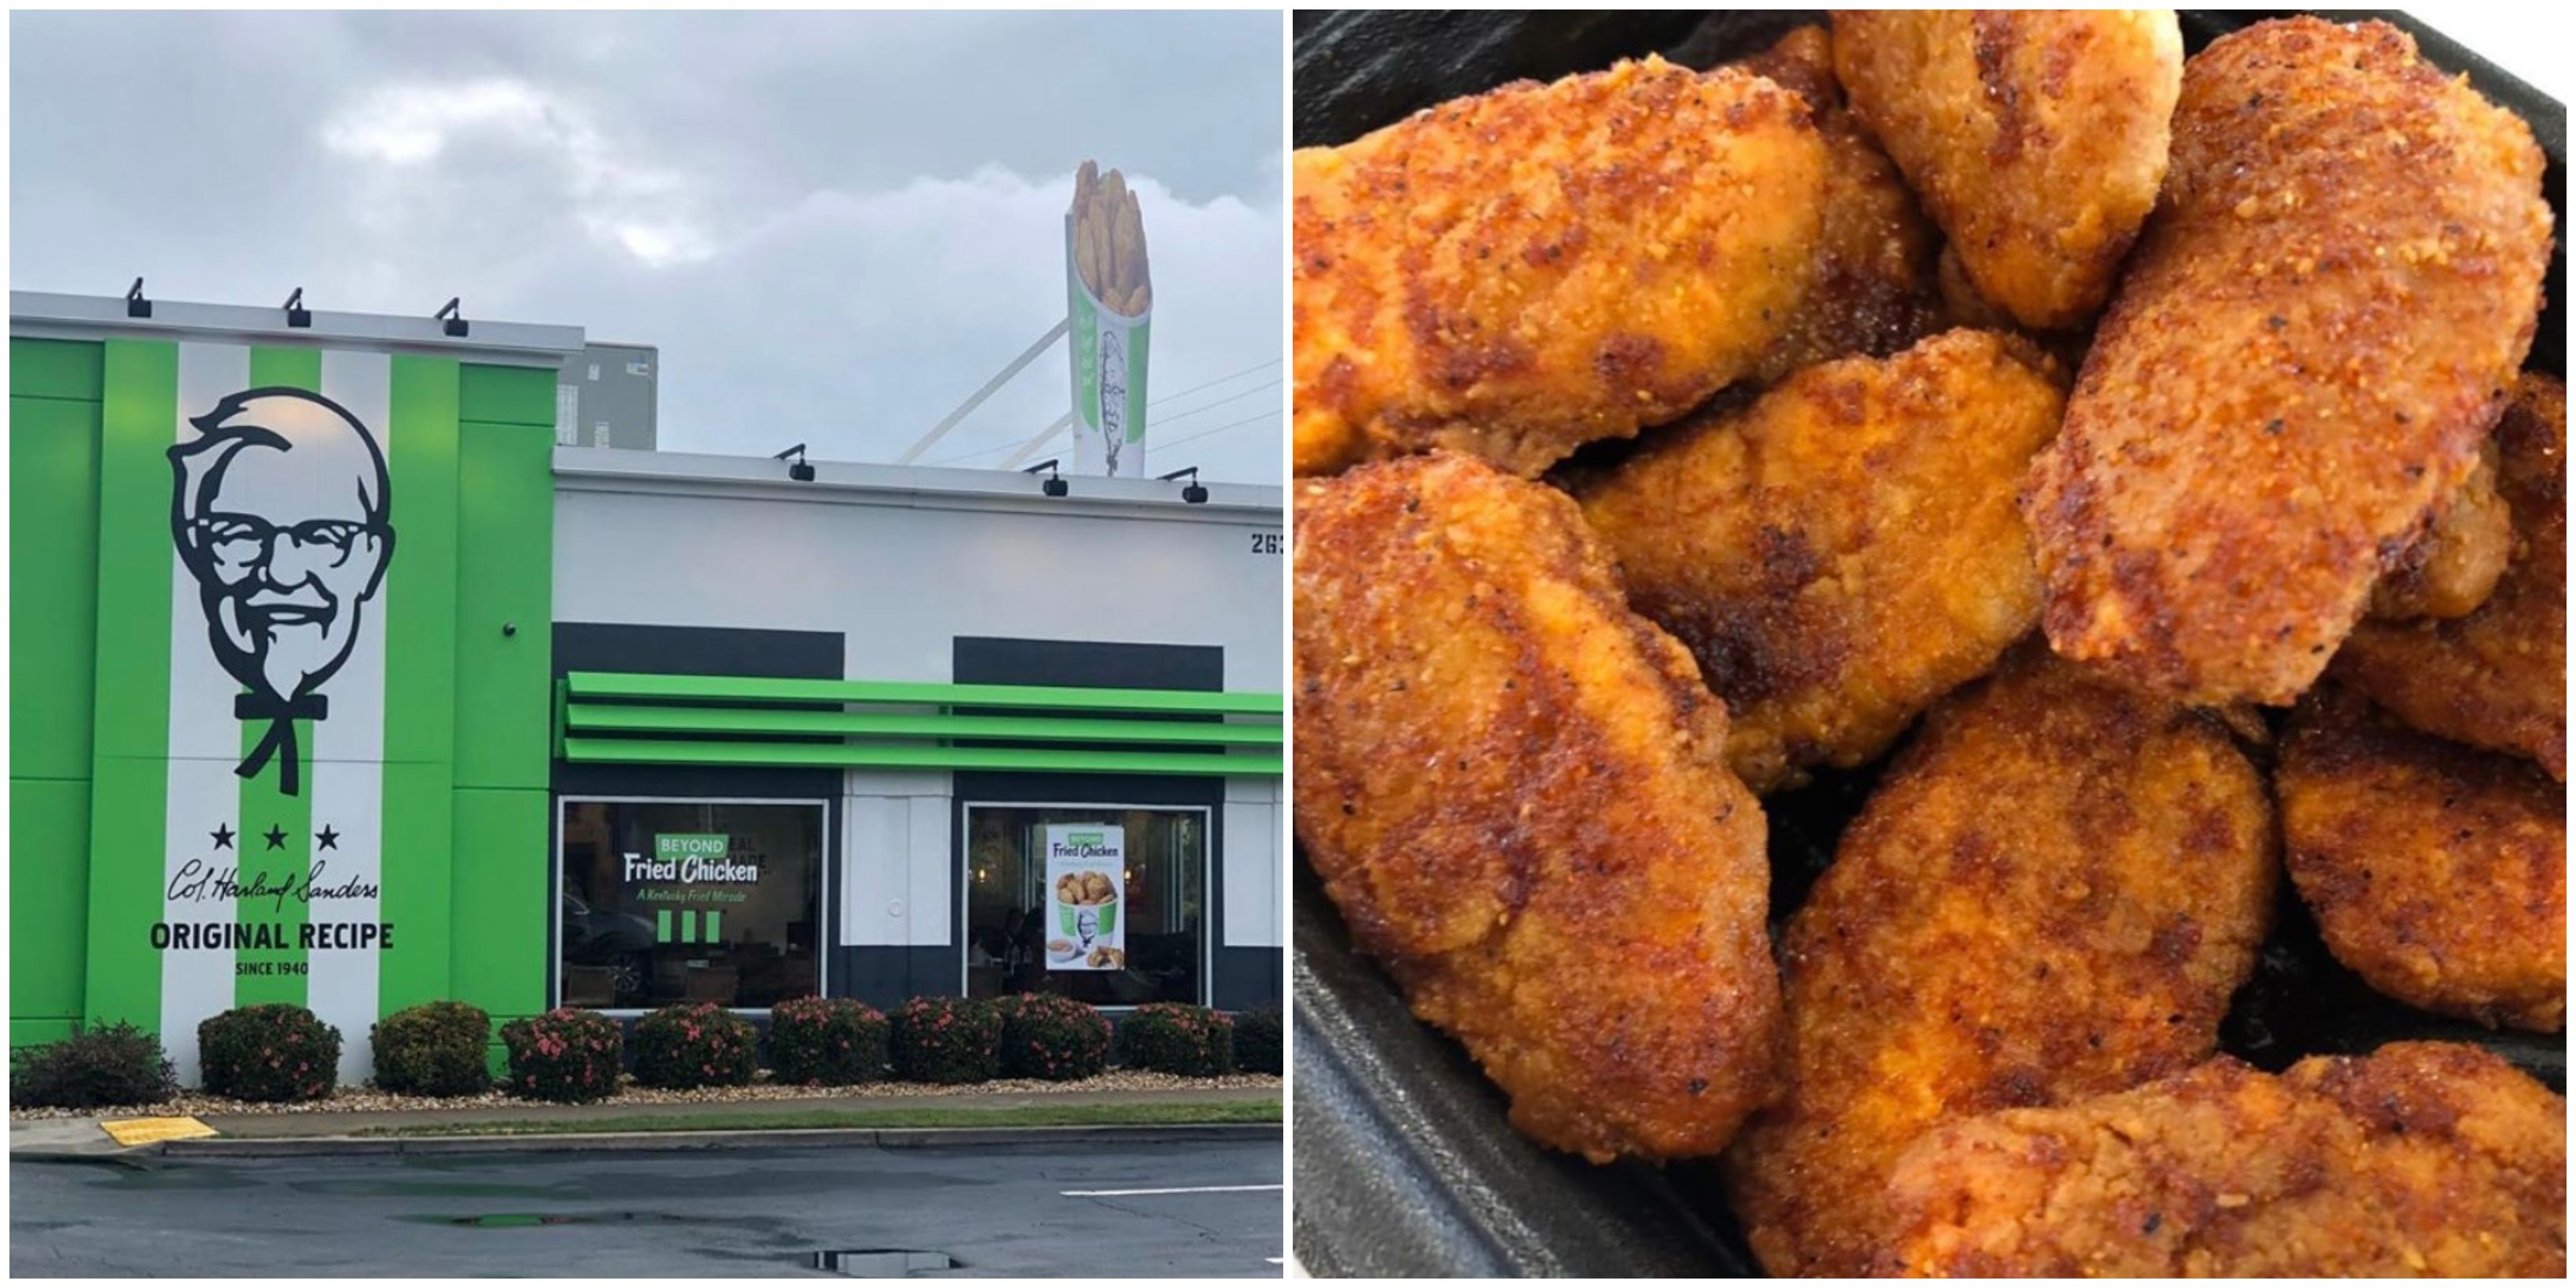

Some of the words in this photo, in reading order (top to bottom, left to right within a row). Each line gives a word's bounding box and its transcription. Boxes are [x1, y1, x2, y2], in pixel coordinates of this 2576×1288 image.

[1252, 534, 1283, 554] 26
[661, 838, 724, 853] BEYOND
[1053, 843, 1079, 858] Fried
[1080, 843, 1119, 859] Chicken
[623, 852, 676, 882] Fried
[680, 855, 758, 883] Chicken
[167, 859, 214, 902] Col.
[211, 867, 296, 913] Harland
[295, 859, 378, 903] Sanders
[636, 888, 646, 901] A
[647, 889, 685, 904] Kentucky
[687, 889, 711, 901] Fried
[150, 922, 290, 949] ORIGINAL
[299, 923, 394, 949] RECIPE
[235, 961, 273, 975] SINCE
[276, 962, 309, 975] 1940
